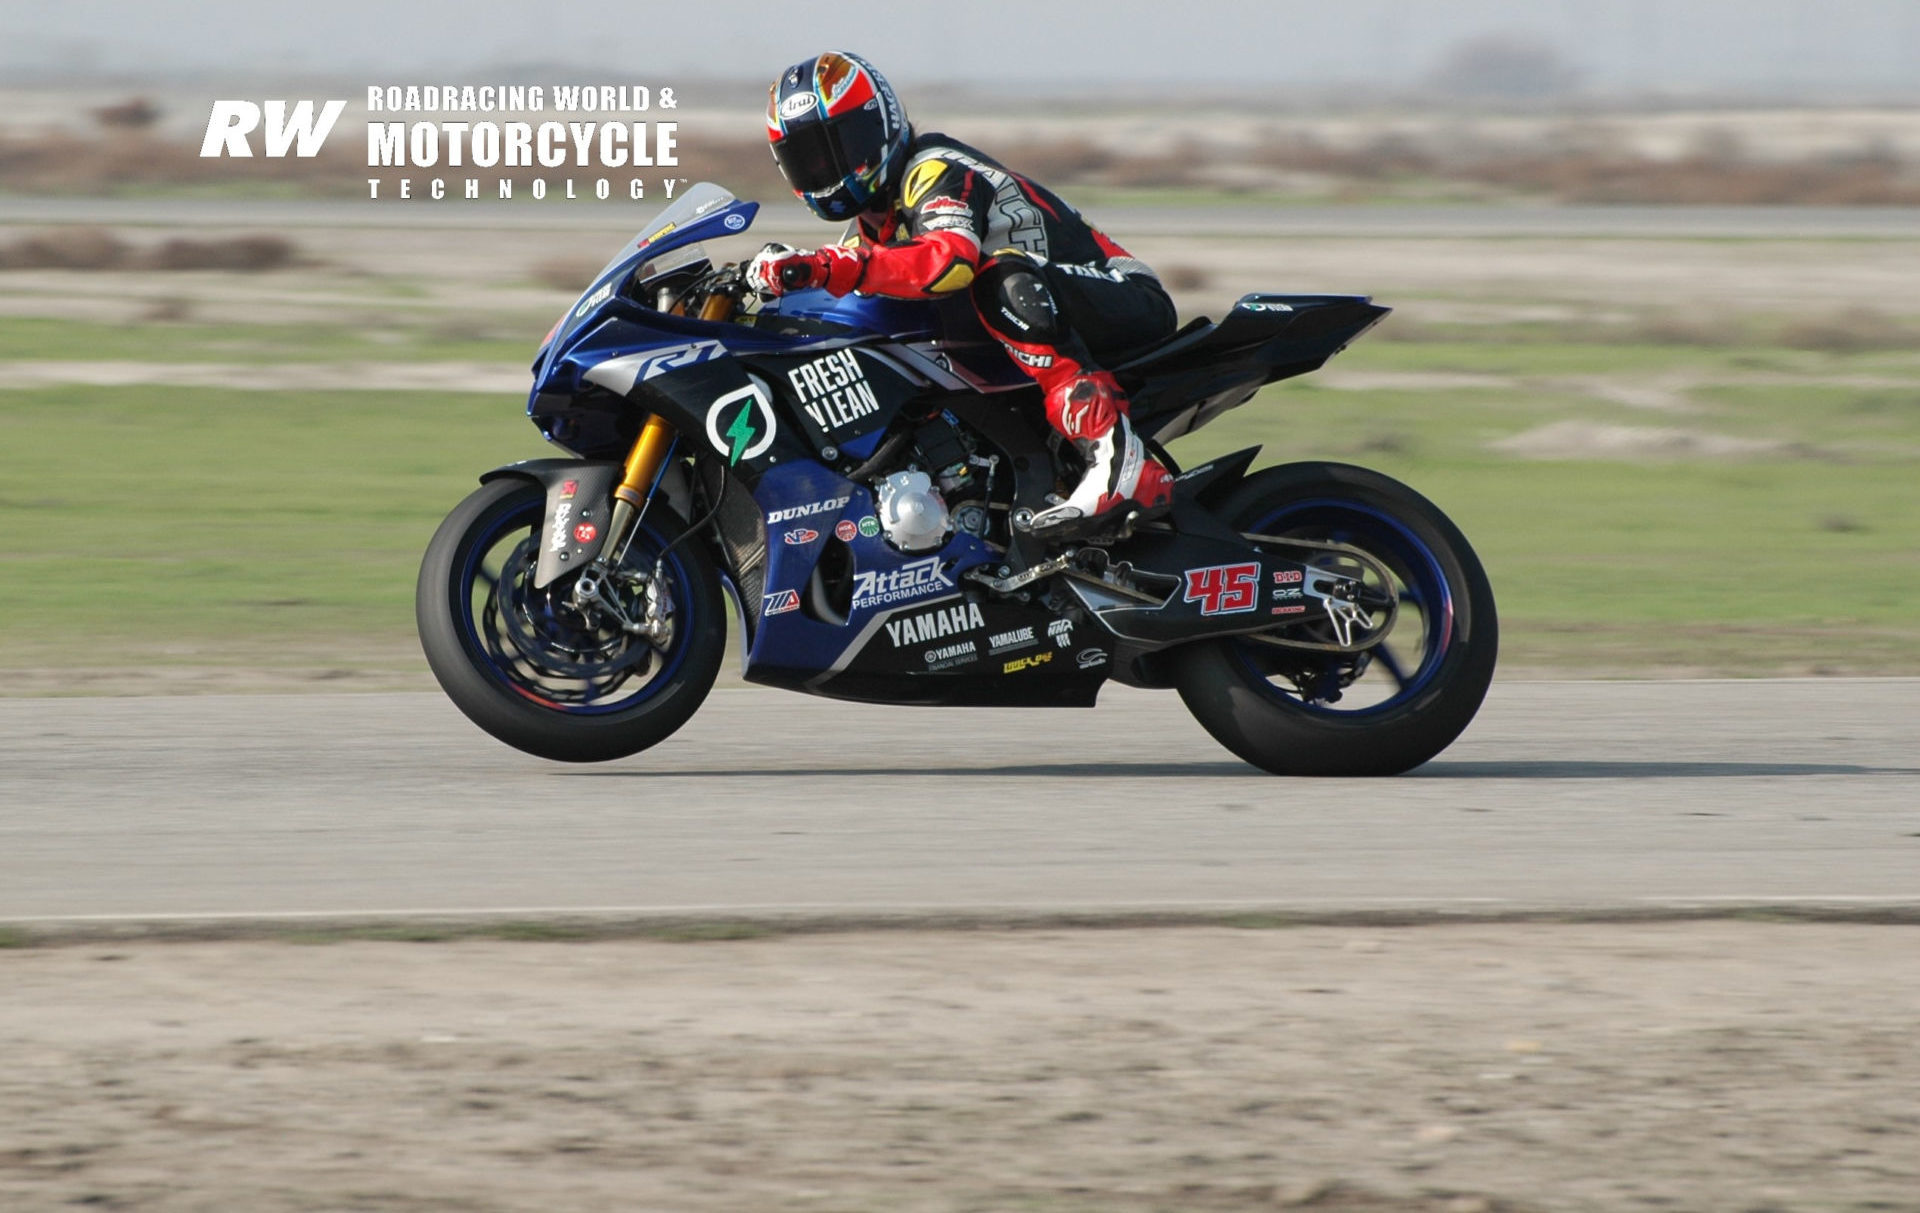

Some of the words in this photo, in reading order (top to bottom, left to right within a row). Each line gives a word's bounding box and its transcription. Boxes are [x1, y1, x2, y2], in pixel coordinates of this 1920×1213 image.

[1000, 306, 1031, 332] TAICHI
[787, 347, 864, 404] FRESH
[821, 380, 880, 429] LEAN
[767, 496, 850, 525] DUNLOP
[852, 581, 943, 610] PERFORMANCE
[1183, 562, 1261, 616] 45
[885, 602, 985, 648] YAMAHA
[989, 626, 1035, 648] YAMALUBE
[935, 641, 976, 660] YAMAHA
